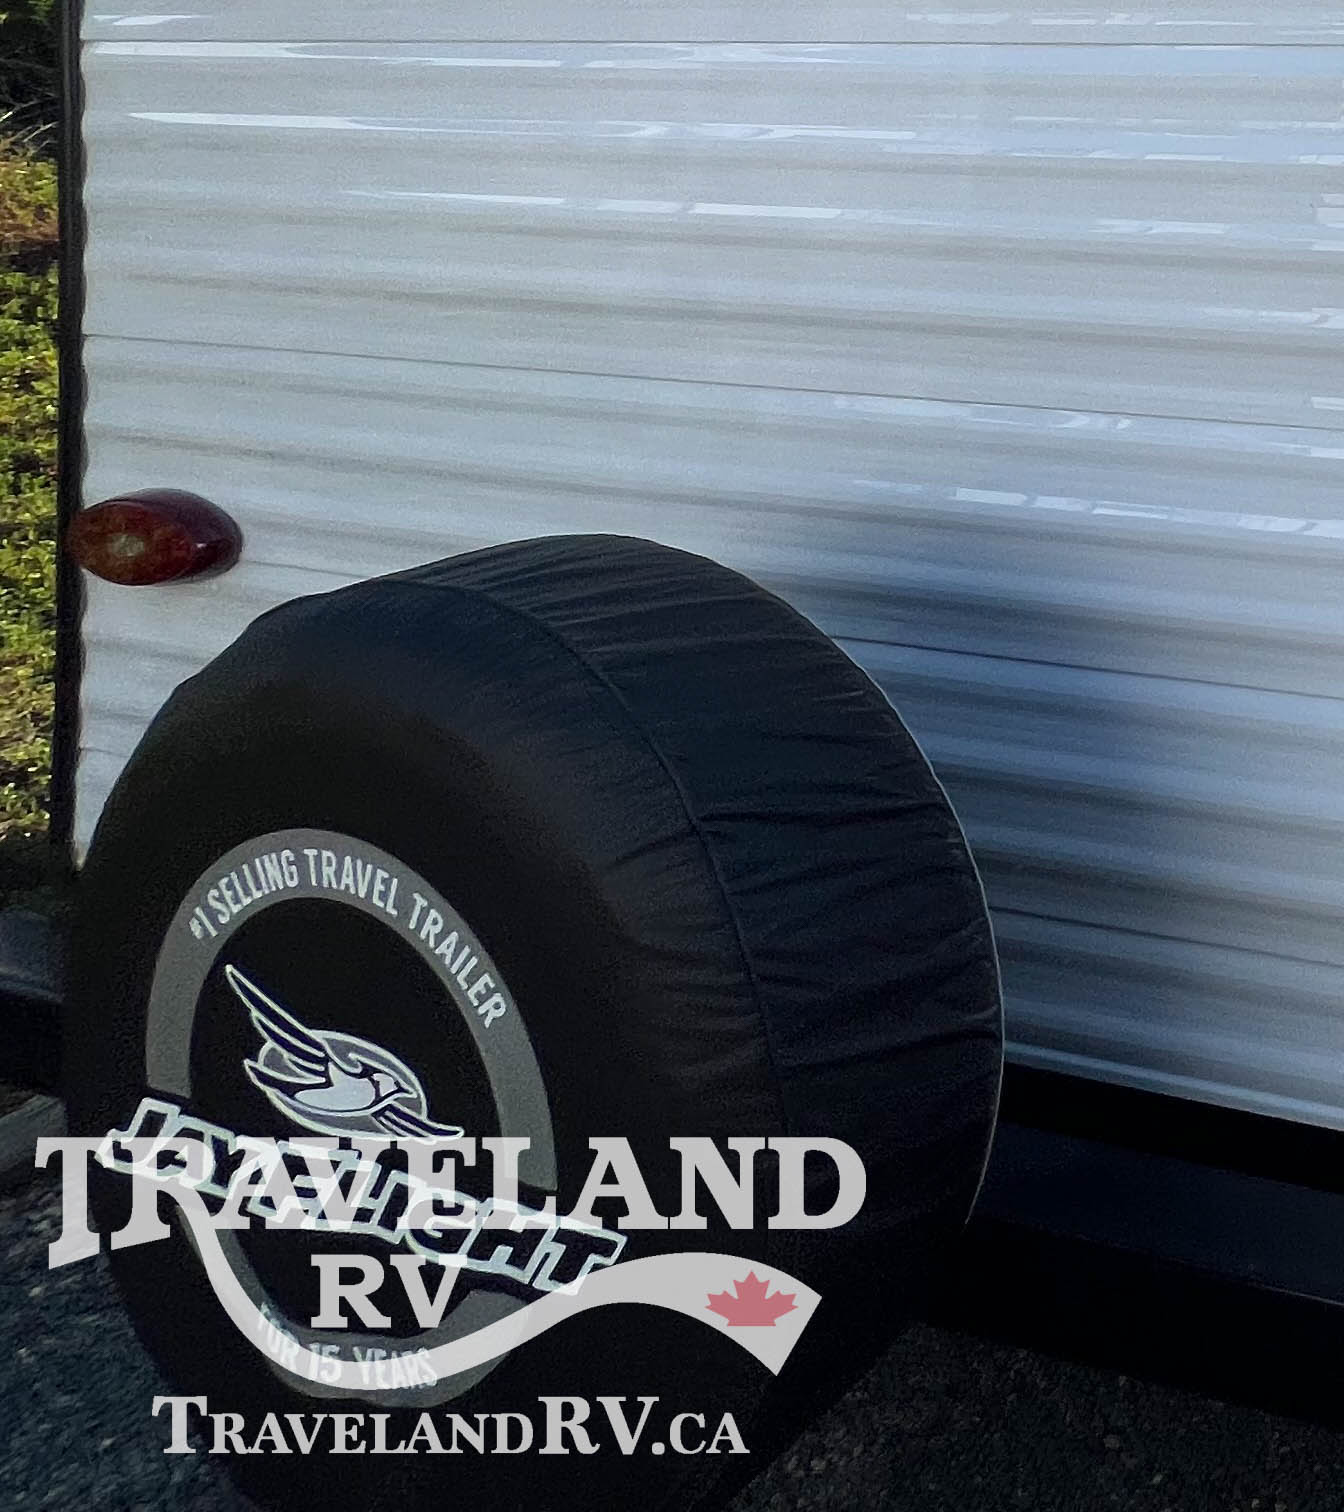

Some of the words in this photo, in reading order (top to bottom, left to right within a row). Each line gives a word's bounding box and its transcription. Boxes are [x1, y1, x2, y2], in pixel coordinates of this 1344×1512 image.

[206, 849, 300, 925] SELLING
[303, 848, 399, 918] TRAVEL
[408, 892, 507, 1029] TRAILER
[308, 1342, 344, 1384] 15
[351, 1346, 440, 1390] YEARS
